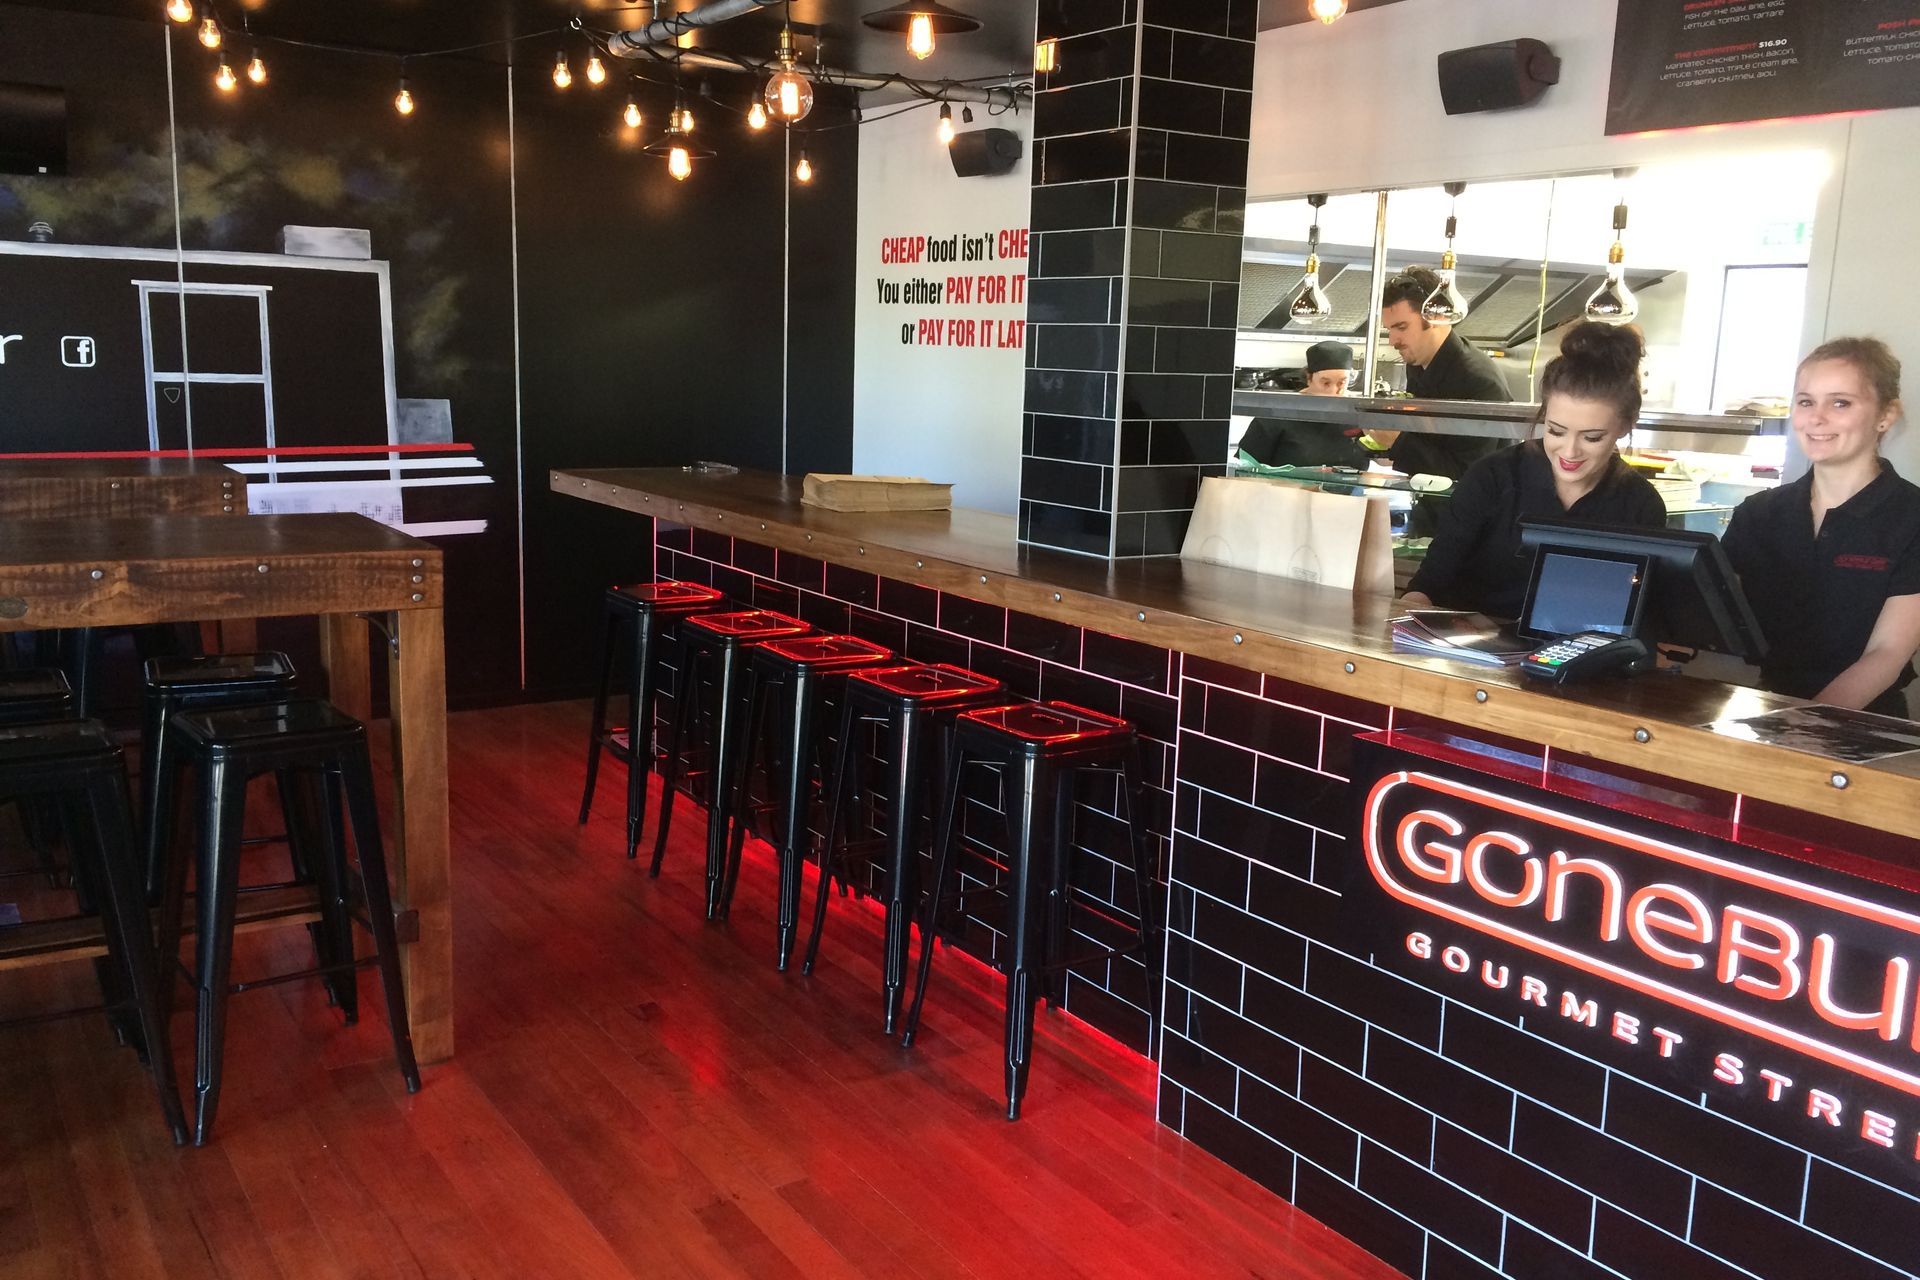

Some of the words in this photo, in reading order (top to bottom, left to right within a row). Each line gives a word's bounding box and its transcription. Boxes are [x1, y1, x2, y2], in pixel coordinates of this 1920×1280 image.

[1758, 38, 1788, 49] $16.90
[881, 236, 925, 264] CHEAP
[927, 234, 958, 262] food
[962, 232, 994, 261] isn't
[877, 278, 899, 304] You
[903, 278, 943, 304] either
[946, 276, 973, 304] PAY
[977, 275, 1006, 304] FOR
[1011, 274, 1026, 304] IT
[901, 323, 915, 345] or
[918, 319, 944, 346] PAY
[948, 319, 976, 347] FOR
[980, 319, 994, 348] IT
[1396, 809, 1920, 1052] GoneBu
[1406, 931, 1684, 1058] GOURMET
[1713, 1053, 1920, 1161] STRE
